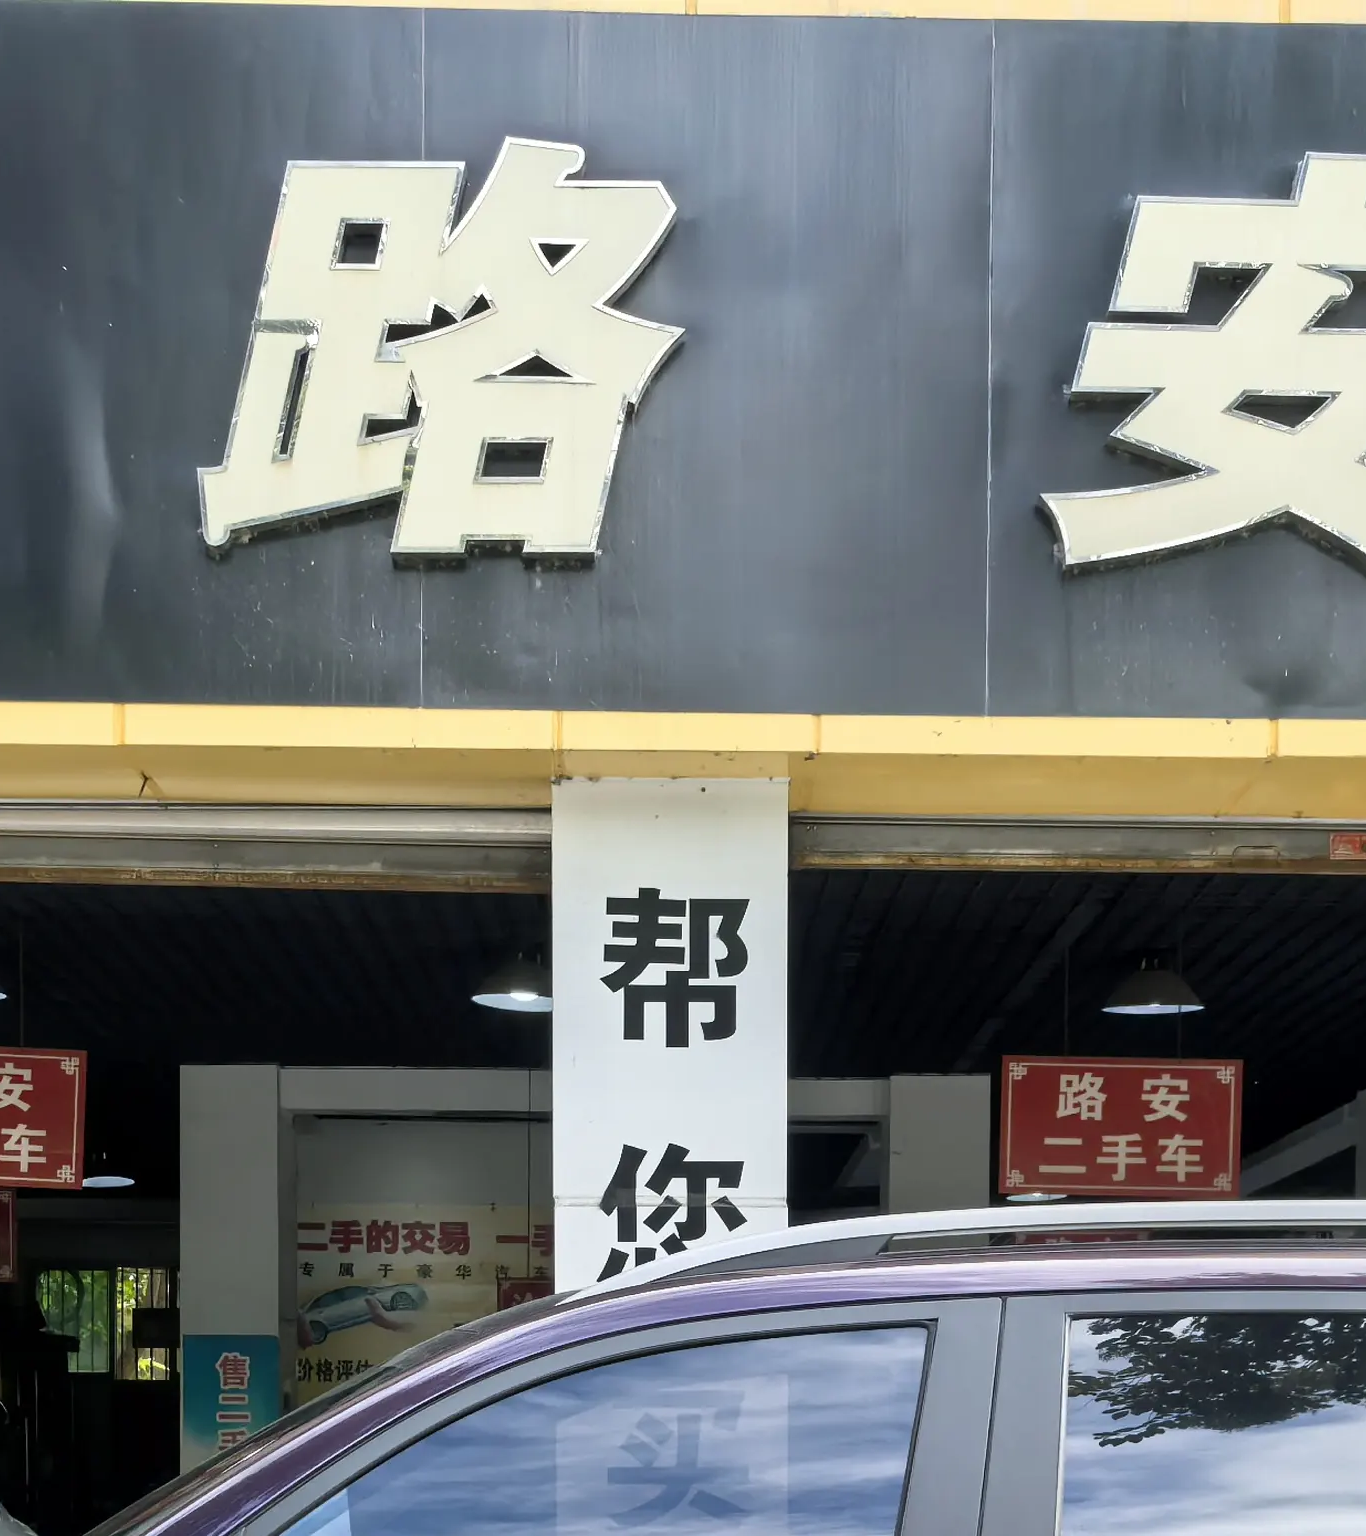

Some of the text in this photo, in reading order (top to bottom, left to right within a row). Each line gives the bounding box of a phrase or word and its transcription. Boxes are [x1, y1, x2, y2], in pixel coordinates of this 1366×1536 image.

[1056, 1072, 1190, 1122] 路安
[1039, 1133, 1203, 1183] 二手车
[297, 1220, 471, 1256] 二手的交易
